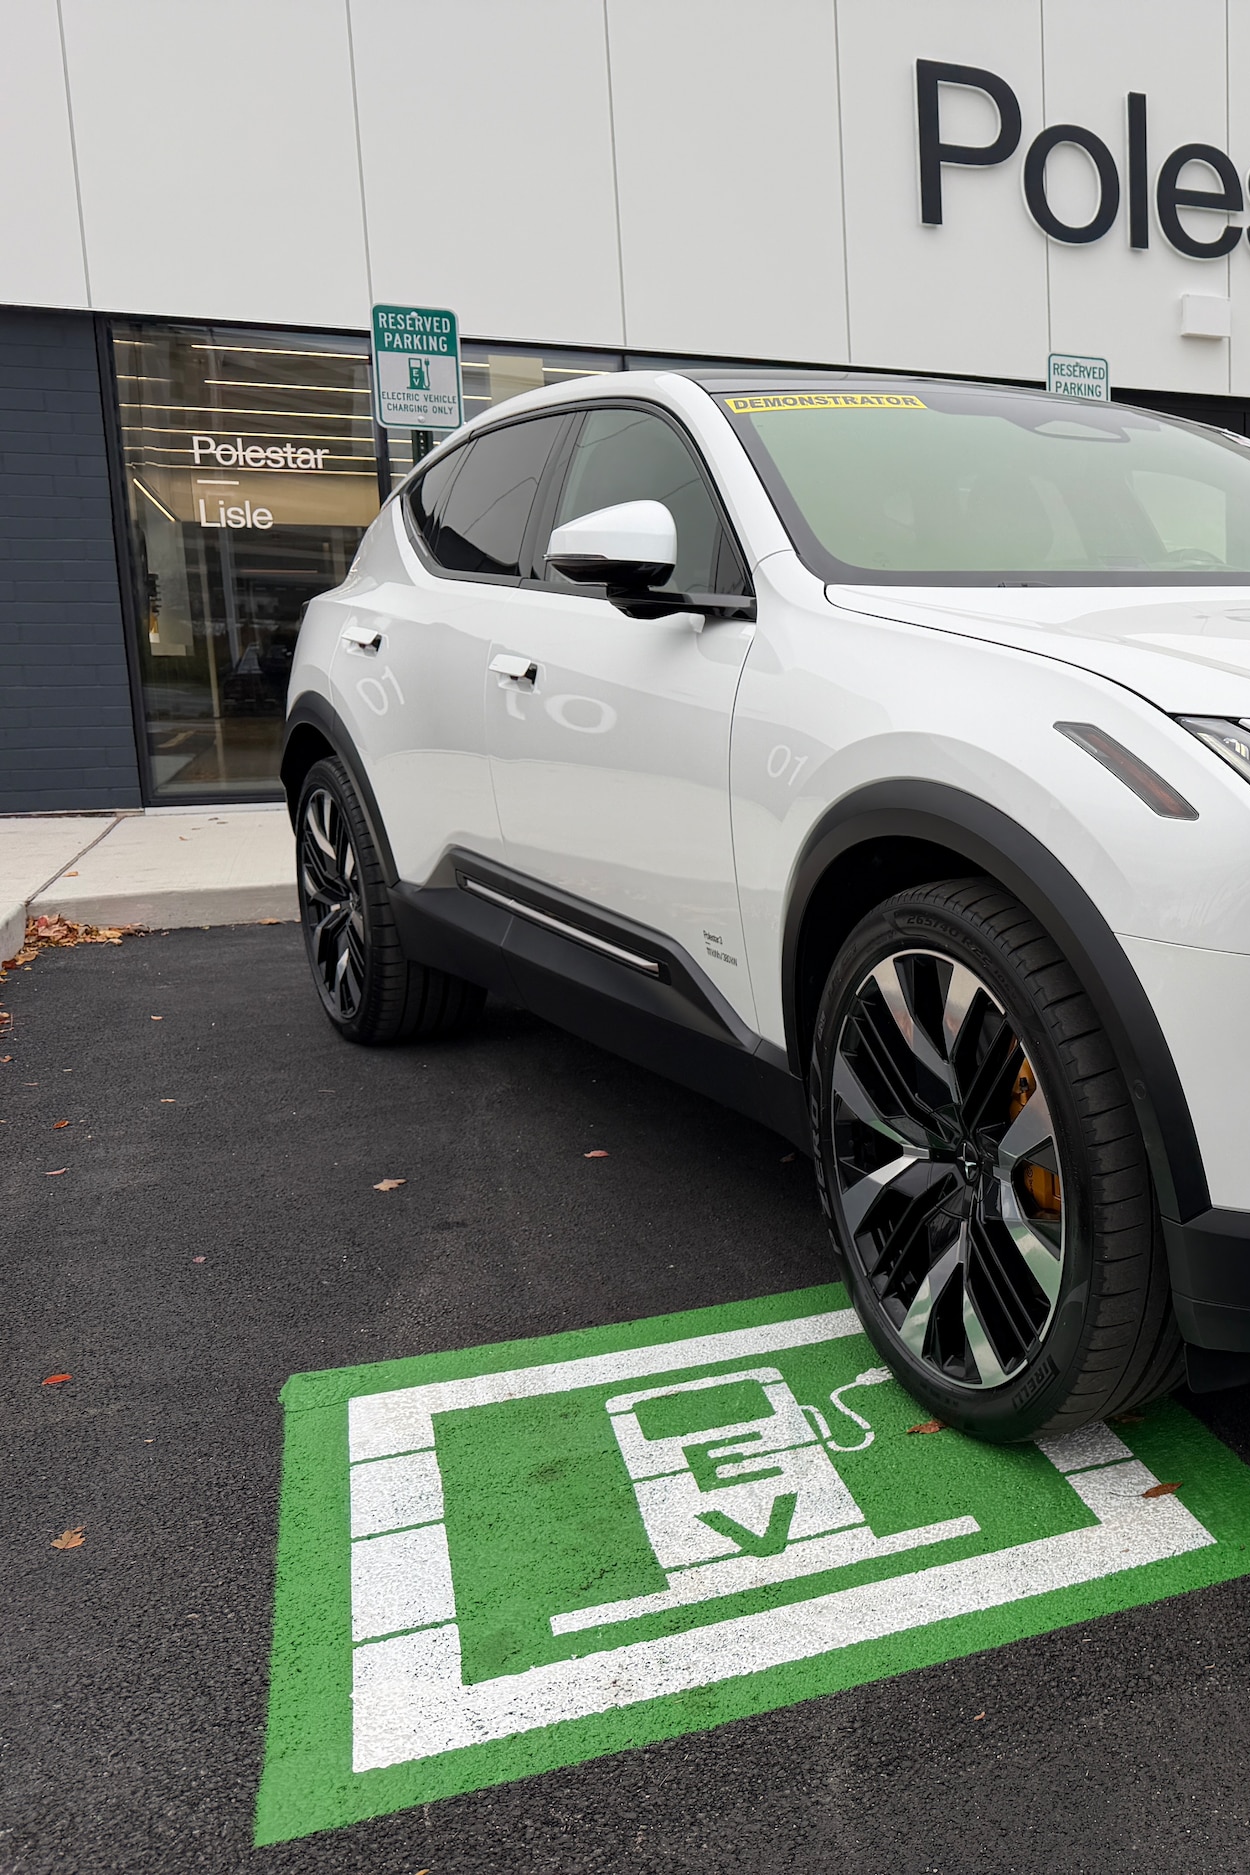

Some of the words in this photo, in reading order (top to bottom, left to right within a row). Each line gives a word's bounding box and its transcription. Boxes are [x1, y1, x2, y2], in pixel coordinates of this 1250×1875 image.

[378, 312, 450, 334] RESERVED
[384, 332, 448, 352] PARKING
[1053, 363, 1105, 380] RESERVED
[382, 391, 420, 402] ELECTRIC
[424, 394, 457, 404] VEHICLE
[1055, 381, 1102, 397] PARKING
[387, 403, 428, 414] CHARGING
[432, 405, 454, 415] ONLY
[735, 395, 920, 410] DEMONSTRATOR
[192, 435, 330, 470] Polestar
[199, 498, 274, 530] Lisle
[681, 1430, 800, 1558] EV
